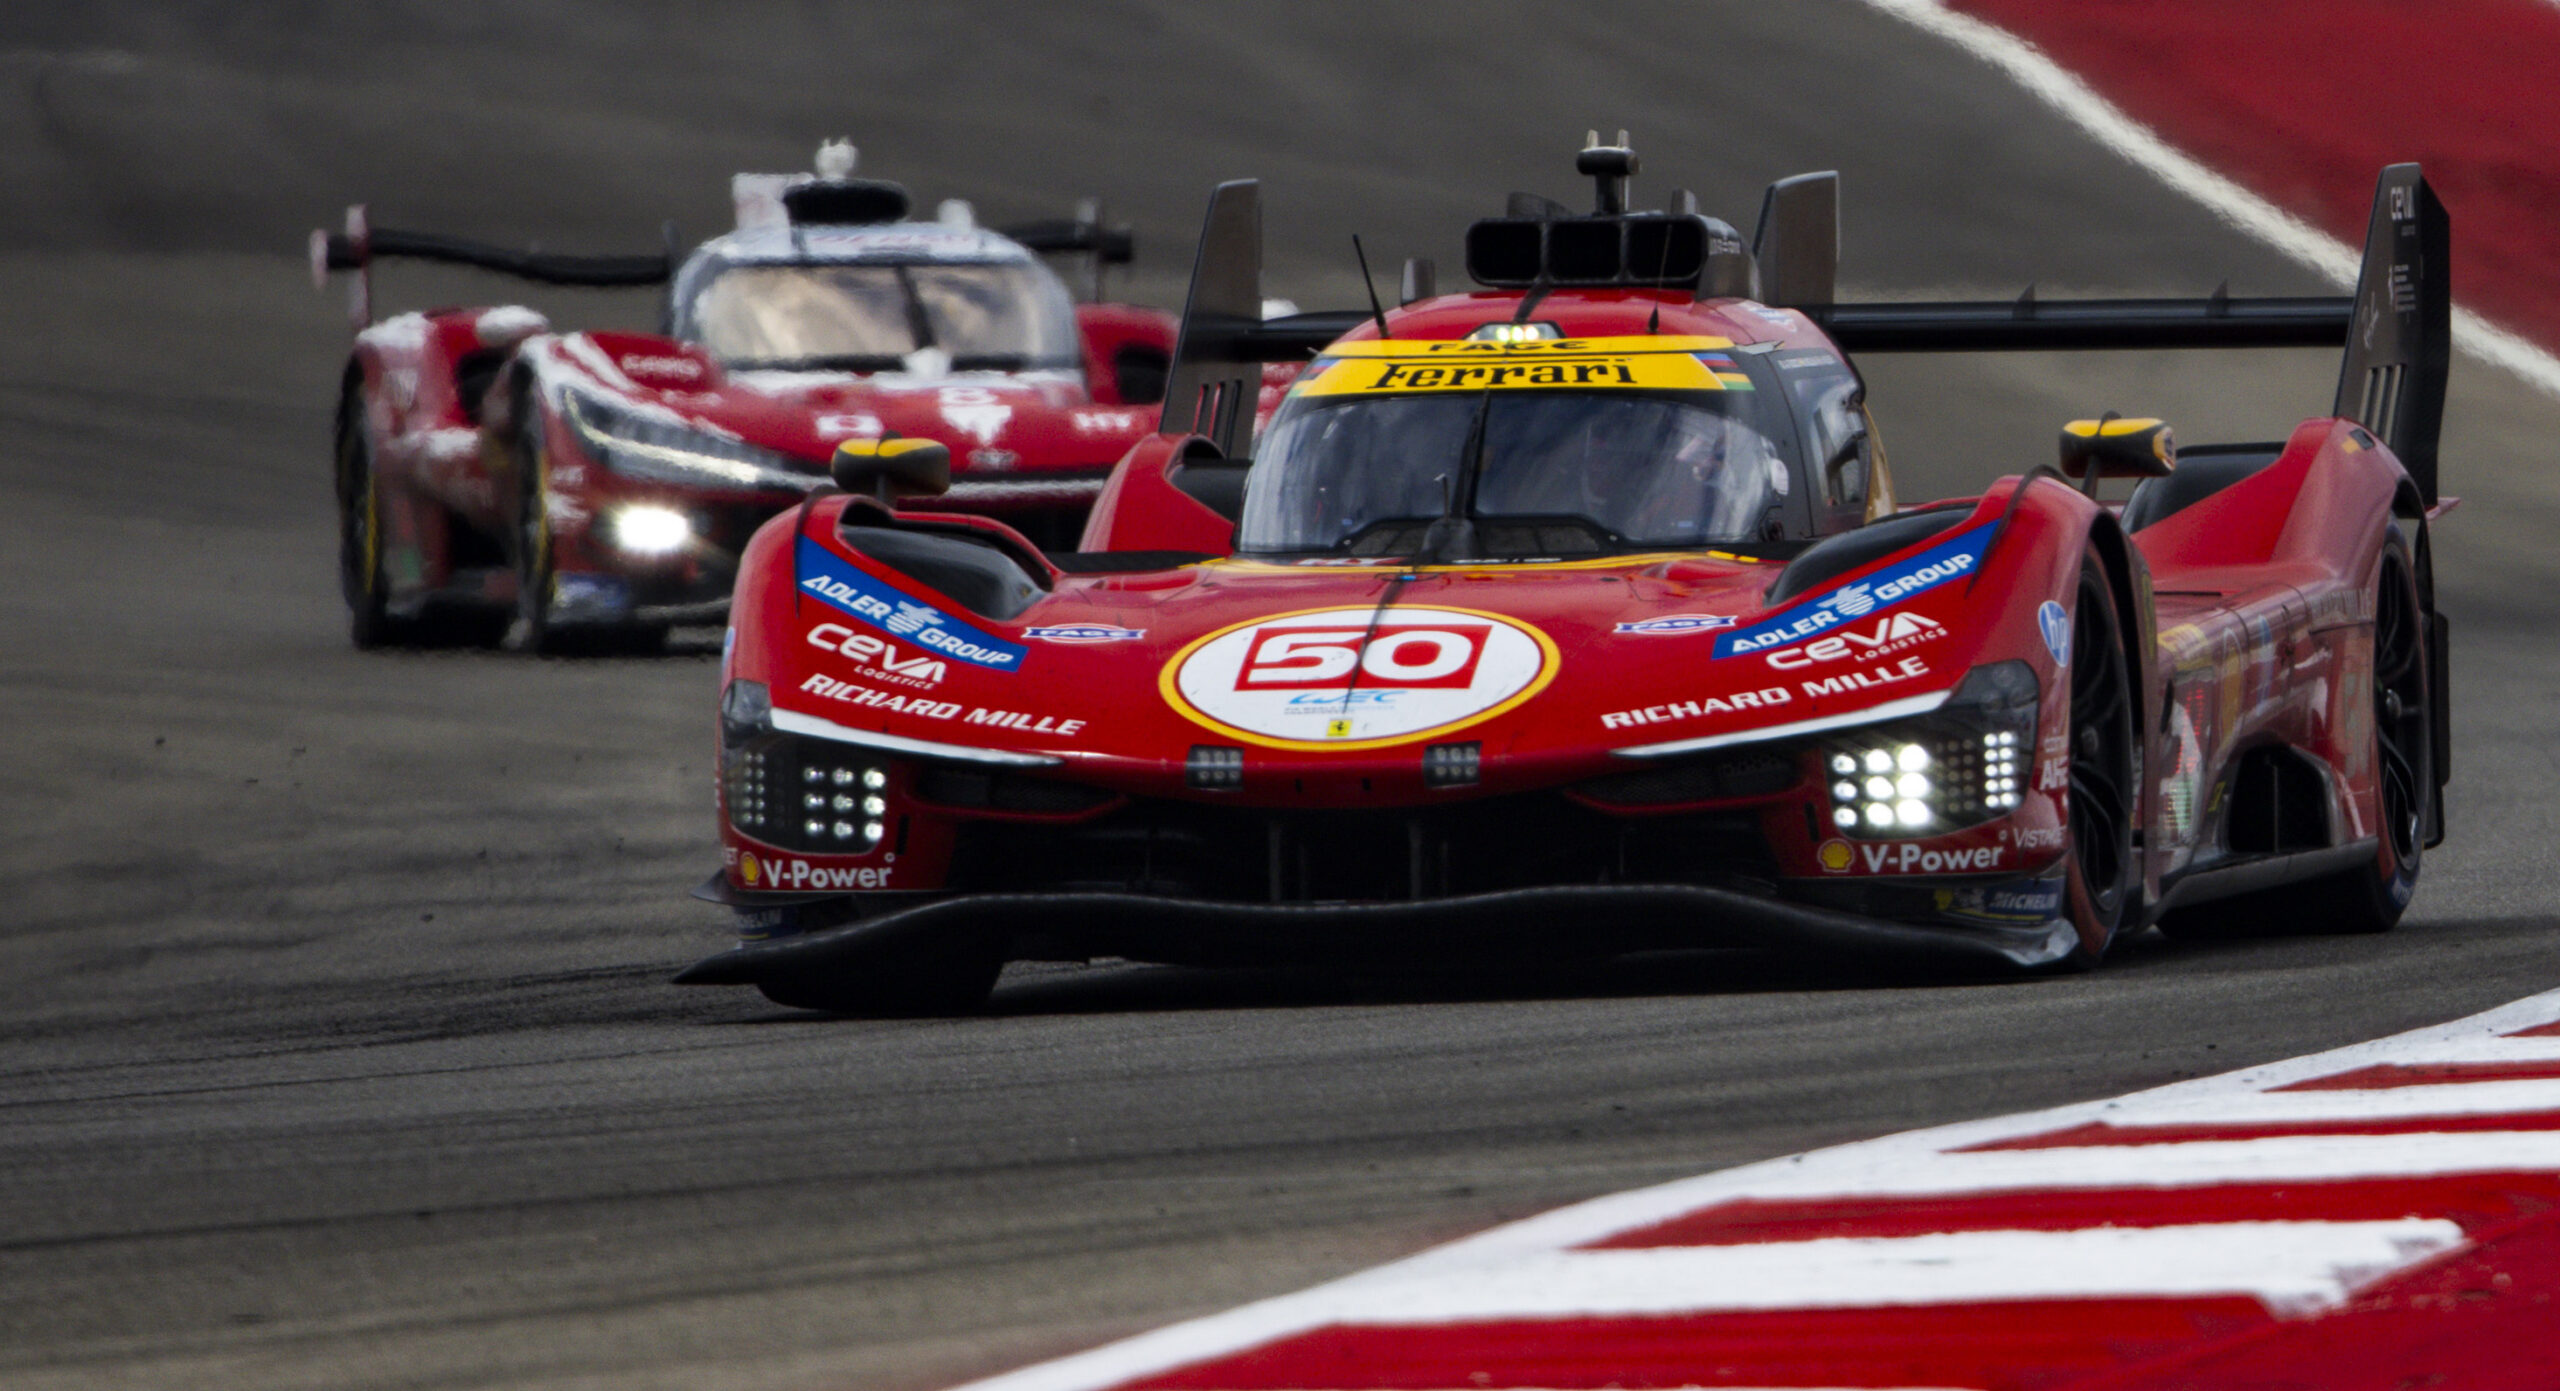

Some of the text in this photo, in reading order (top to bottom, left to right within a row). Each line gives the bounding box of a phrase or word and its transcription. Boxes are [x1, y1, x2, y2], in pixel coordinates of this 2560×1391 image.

[1366, 359, 1637, 389] Ferrari
[801, 574, 1015, 665] ADLER GROUP
[1731, 553, 1975, 654] ADLER GROUP
[806, 622, 949, 684] CEVA
[1247, 630, 1473, 684] 50
[1765, 611, 1943, 671] CEVA
[1854, 626, 1948, 663] LOGISTICS
[800, 672, 1087, 737] RICHARD MILLE
[853, 664, 936, 691] LOGISTICS
[1288, 690, 1409, 704] WEC
[1601, 655, 1930, 730] RICHARD MILLE
[762, 859, 894, 889] V-Power
[1862, 843, 2004, 873] V-Power
